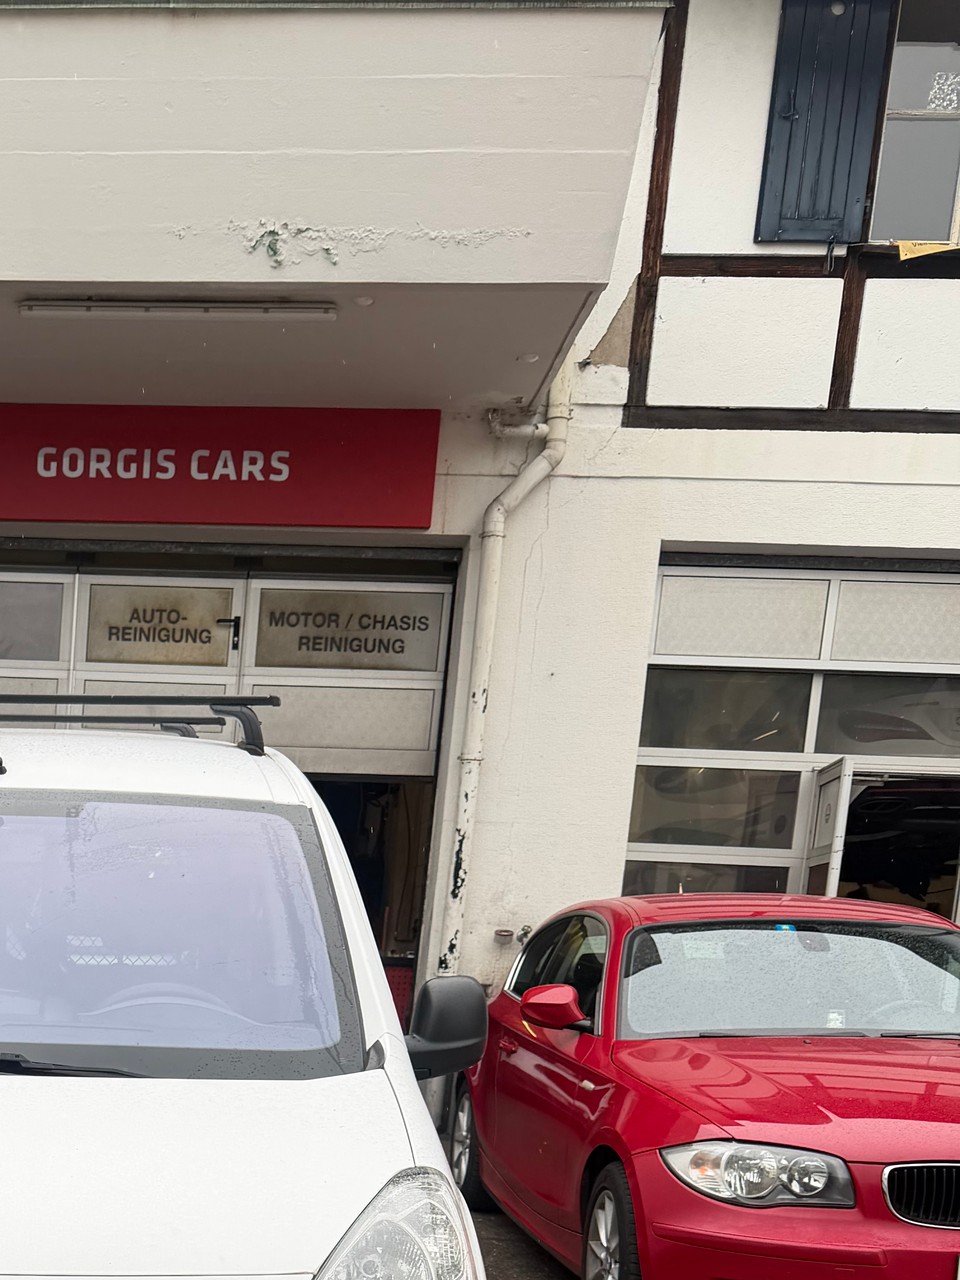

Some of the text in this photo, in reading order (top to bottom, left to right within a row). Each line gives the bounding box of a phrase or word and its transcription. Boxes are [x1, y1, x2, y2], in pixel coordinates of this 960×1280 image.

[36, 446, 291, 482] GORGIS CARS
[128, 608, 188, 625] AUTO-
[268, 611, 430, 632] MOTOR / CHASIS
[107, 626, 212, 644] REINIGUNG
[297, 636, 406, 654] REINIGUNG
